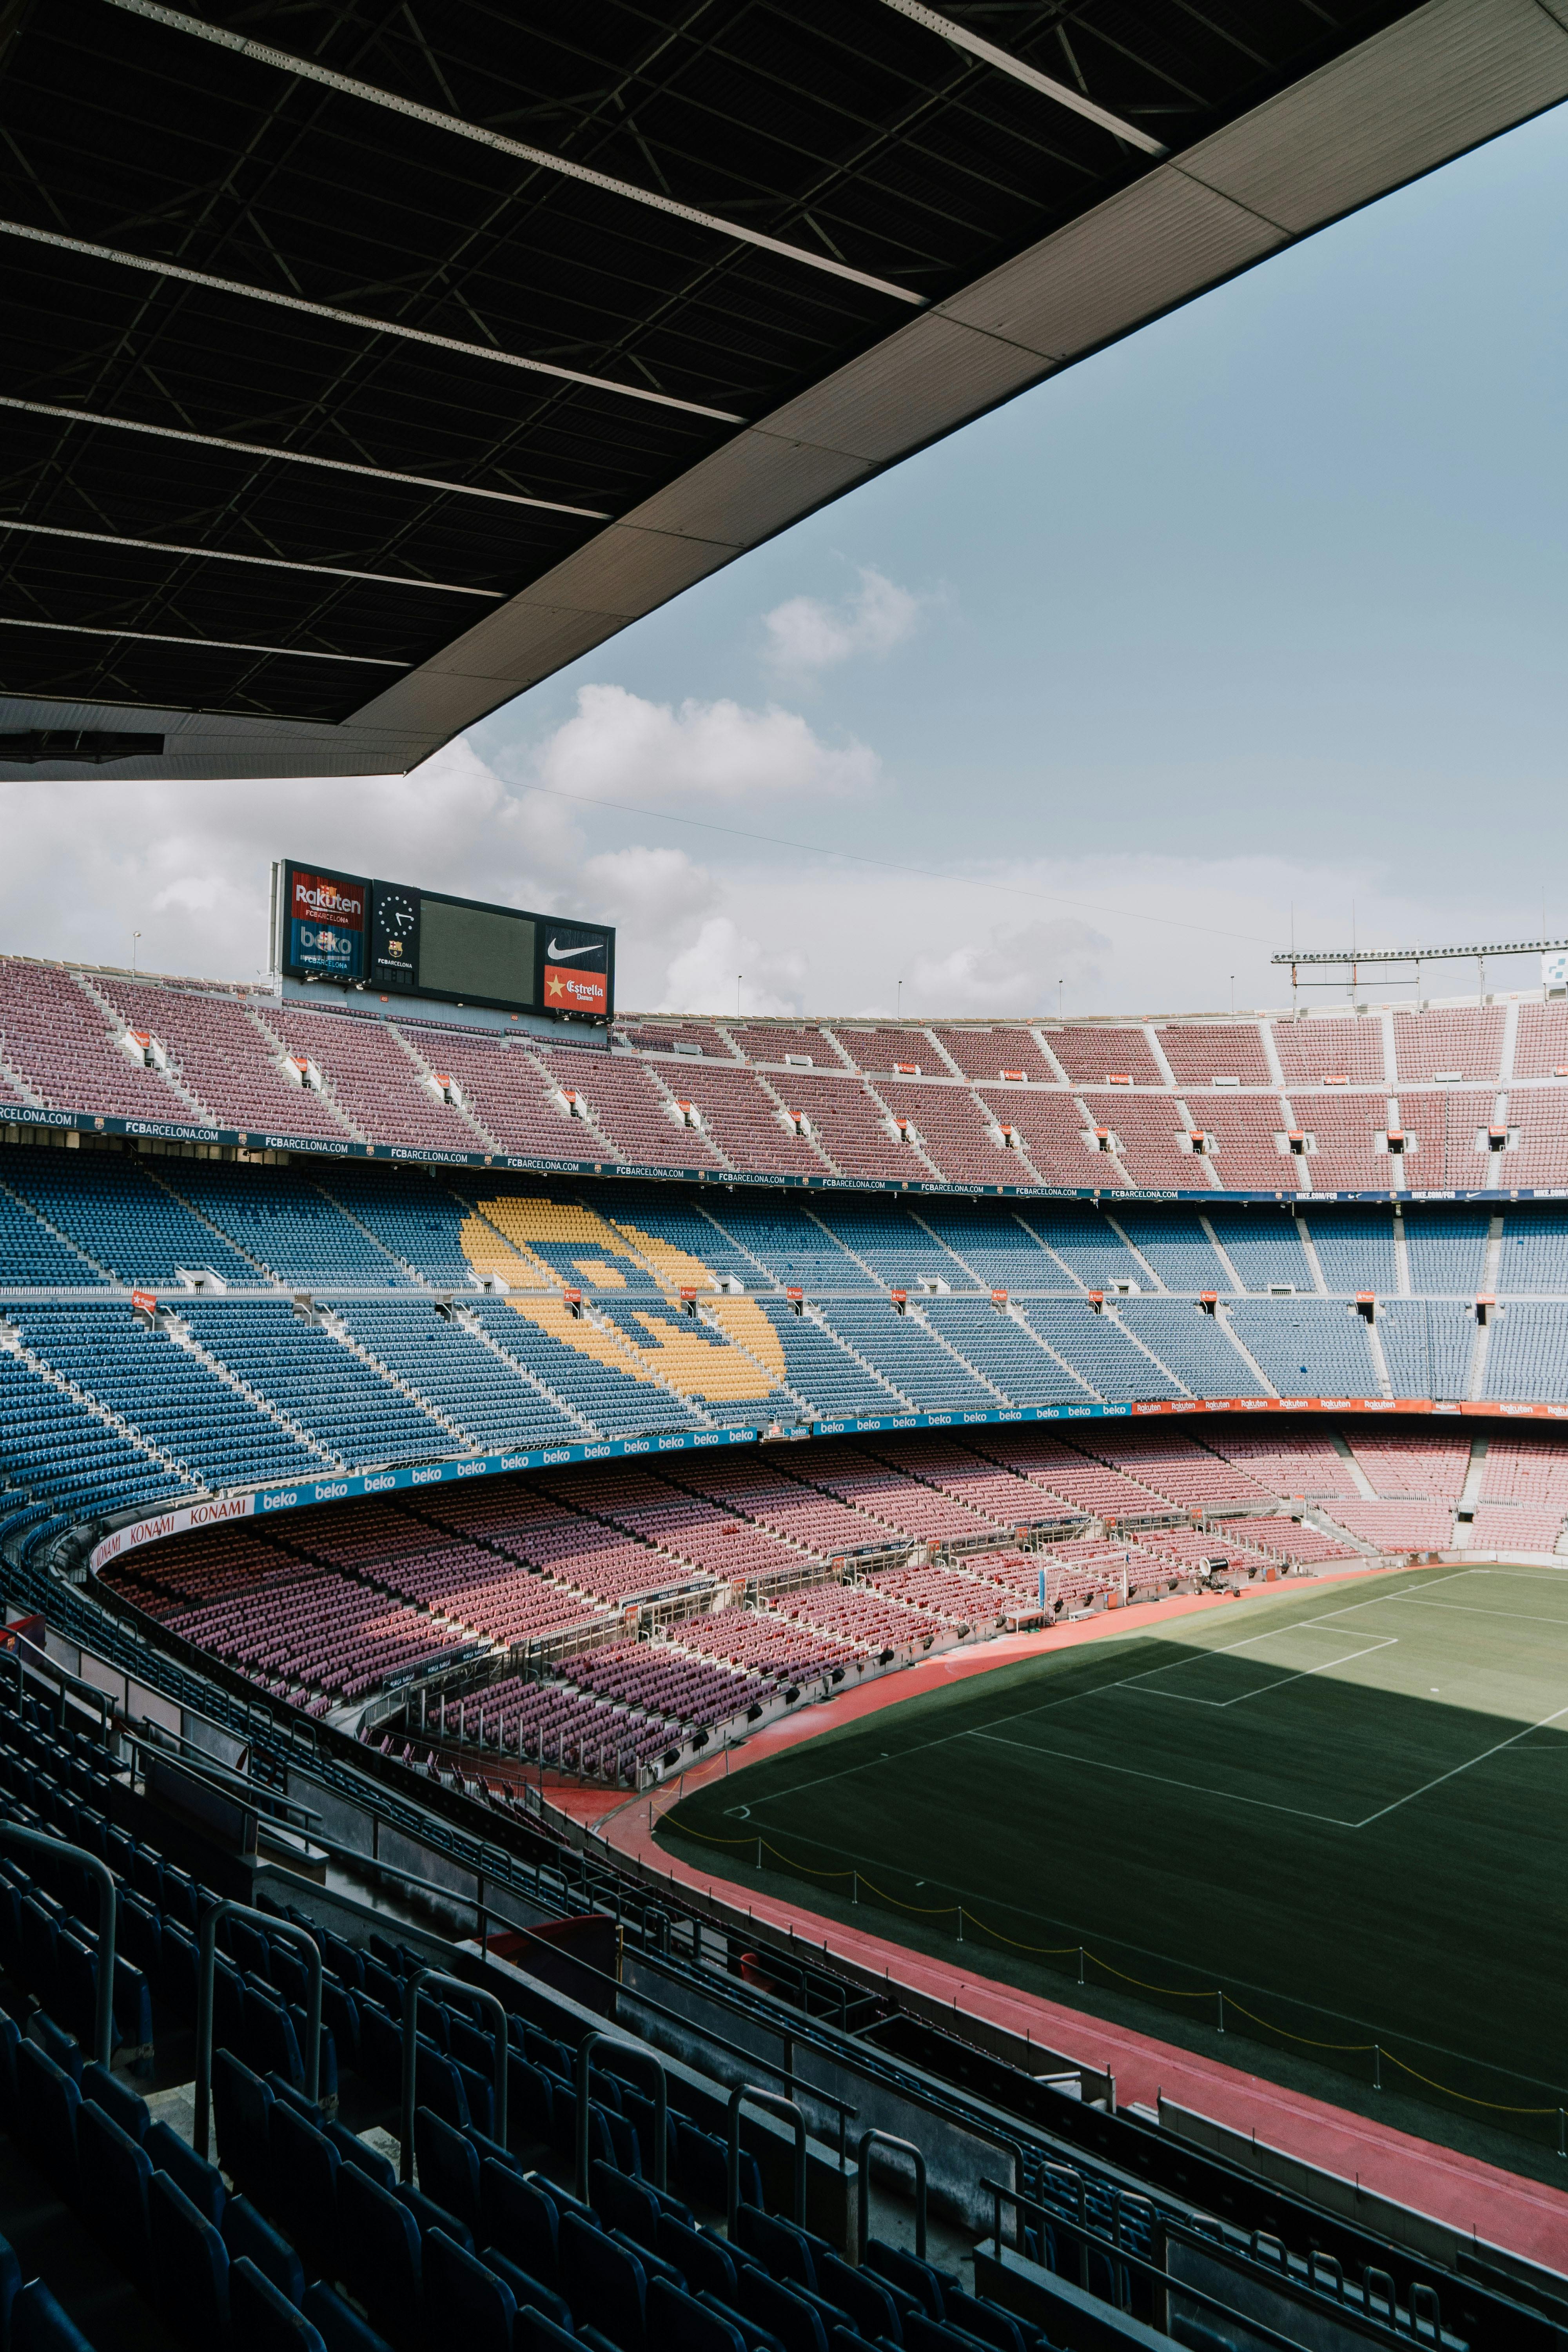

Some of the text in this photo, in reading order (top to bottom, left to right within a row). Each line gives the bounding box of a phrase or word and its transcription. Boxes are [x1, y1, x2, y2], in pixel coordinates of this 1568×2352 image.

[296, 884, 361, 915] Rakuten
[378, 958, 412, 968] FCBARCELONA
[566, 980, 603, 997] Estrella
[577, 993, 593, 1002] Damm
[126, 1122, 218, 1141] FCBARCELONA.COM
[265, 1137, 348, 1153] FCBARCELONA.COM
[392, 1149, 467, 1163] FCBARCELONA.COM
[508, 1158, 579, 1171] FCBARCELONA.COM
[617, 1167, 683, 1178] FCBARCELONA.COM
[719, 1173, 784, 1183] FCBARCELONA.COM
[823, 1179, 885, 1189] FCBARCELONA.COM
[922, 1184, 984, 1193] FCBARCELONA.COM
[1016, 1188, 1077, 1196] FCBARCELONA.COM
[1534, 1189, 1568, 1197] NIKE.COM/
[1172, 1401, 1195, 1410] Rakuten
[1279, 1399, 1308, 1408] Rakuten
[1321, 1399, 1350, 1408] Rakuten
[1365, 1400, 1396, 1408] Rakuten
[1500, 1405, 1533, 1413] Rakuten
[999, 1410, 1022, 1420] beko
[1037, 1408, 1059, 1418] beko
[1068, 1406, 1091, 1416] beko
[1103, 1405, 1126, 1415] beko
[893, 1417, 916, 1427] beko
[928, 1414, 951, 1425] beko
[964, 1412, 987, 1423] beko
[821, 1422, 844, 1433] beko
[857, 1419, 880, 1430] beko
[729, 1429, 753, 1441] beko
[791, 1427, 807, 1435] beko
[659, 1436, 684, 1449] beko
[693, 1432, 719, 1445] beko
[584, 1444, 610, 1458] beko
[624, 1440, 650, 1453] beko
[501, 1455, 529, 1470] beko
[543, 1450, 570, 1464] beko
[457, 1461, 486, 1476] beko
[412, 1468, 442, 1484] beko
[364, 1475, 396, 1492] beko
[315, 1483, 347, 1500] beko
[263, 1492, 297, 1510] beko
[191, 1499, 245, 1525] KONAMI
[130, 1516, 174, 1545] KONAMI
[96, 1535, 120, 1567] KONAMI
